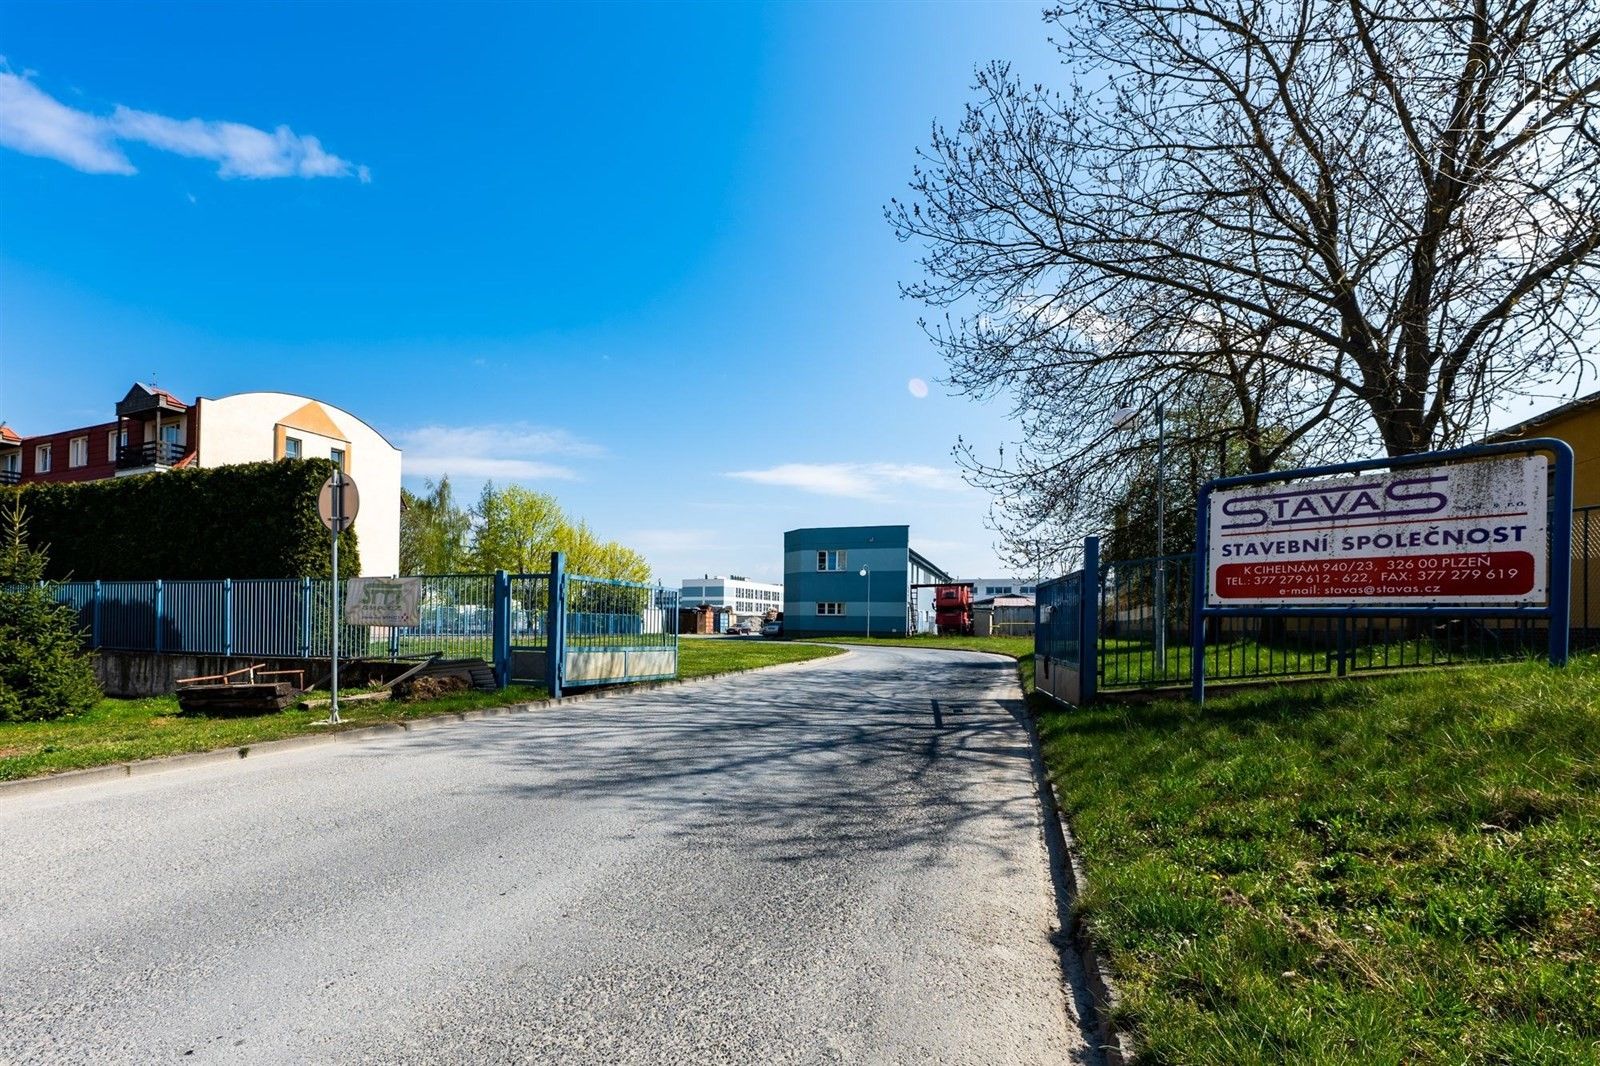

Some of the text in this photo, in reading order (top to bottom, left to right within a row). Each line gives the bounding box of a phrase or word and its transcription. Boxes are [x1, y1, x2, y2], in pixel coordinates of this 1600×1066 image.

[1221, 476, 1448, 529] STAVAS
[1222, 526, 1527, 557] STAVEBNÍ SPOLEČNOST
[1244, 554, 1491, 575] K CIHELNÁM 940/23, 326 00 PLZEŇ
[1226, 576, 1250, 586] TEL.:
[1254, 576, 1278, 585] 377
[1281, 575, 1303, 584] 279
[1306, 574, 1330, 584] 612
[1343, 573, 1373, 584] 622,
[1381, 571, 1413, 581] FAX:
[1418, 570, 1446, 581] 377
[1451, 569, 1481, 580] 279
[1486, 568, 1519, 580] 619
[1279, 585, 1441, 595] e-mail: stavas@stavas.cz
